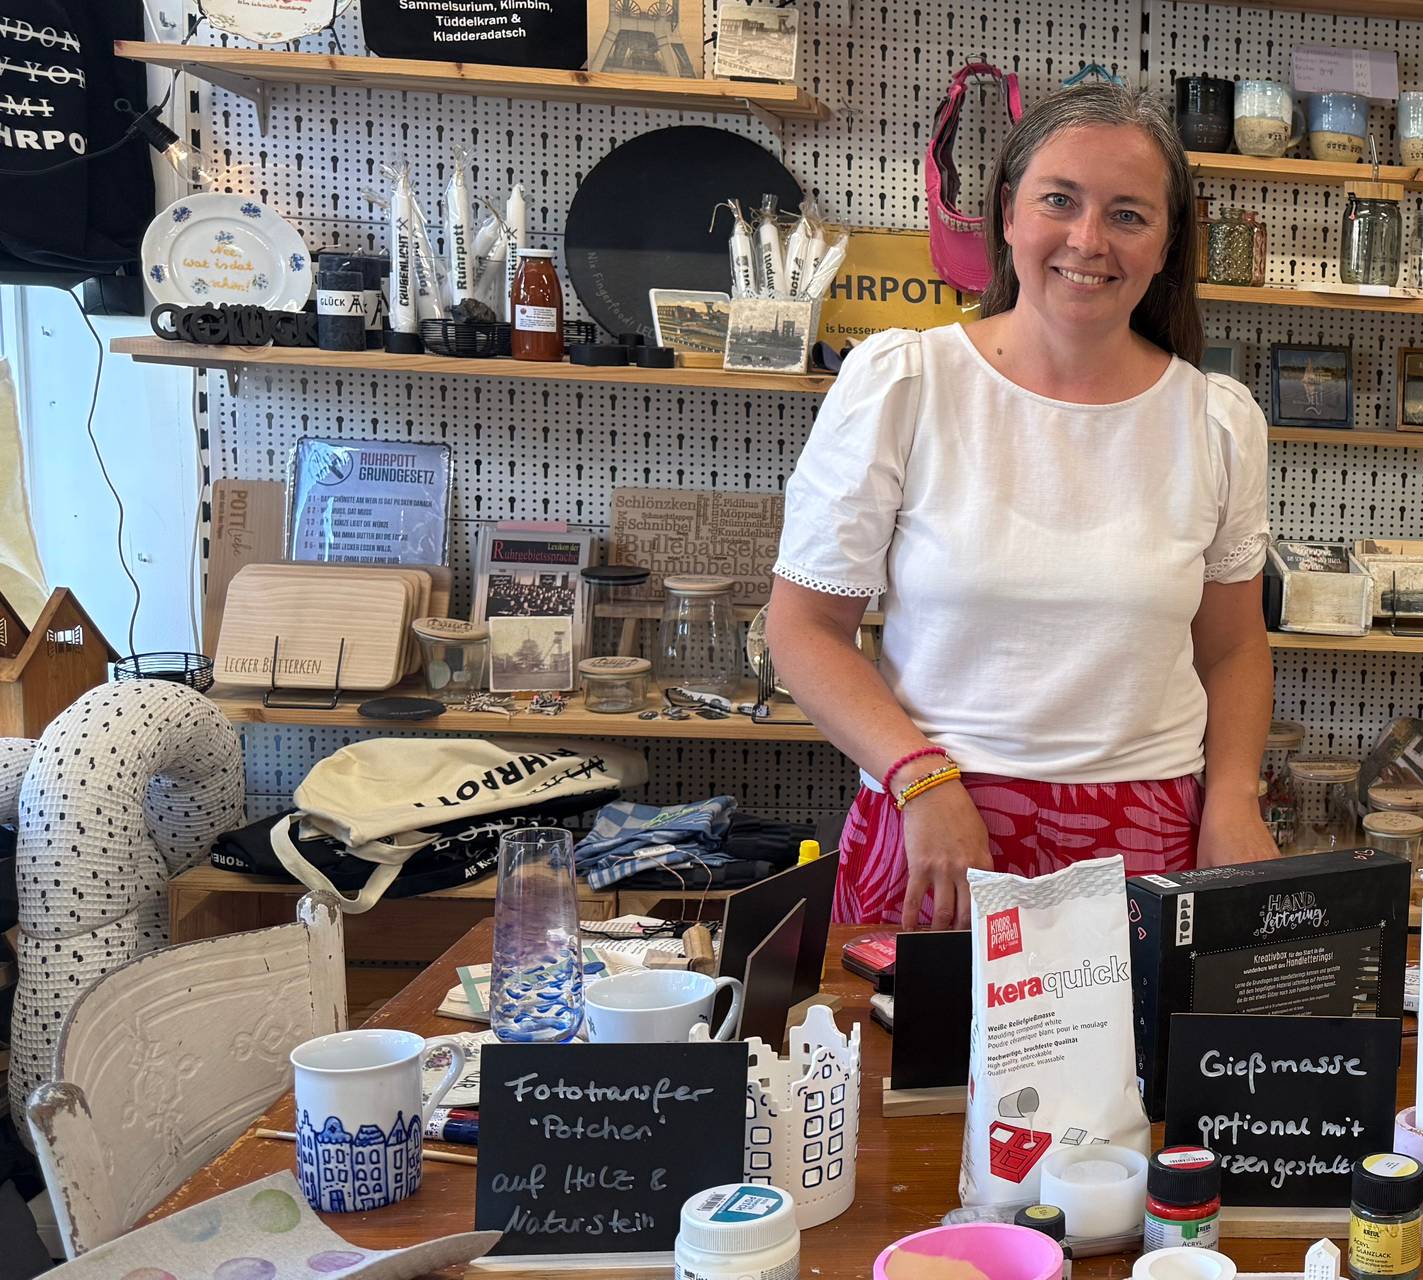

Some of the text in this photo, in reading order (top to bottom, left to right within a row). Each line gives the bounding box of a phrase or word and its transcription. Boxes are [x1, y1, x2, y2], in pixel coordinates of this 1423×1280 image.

[400, 1, 497, 12] Sammelsurium,
[436, 14, 521, 27] Tüddelkram &
[433, 27, 526, 42] Kladderadatsch
[0, 123, 88, 155] HRPO
[455, 223, 468, 290] Ruhrpott
[320, 298, 345, 307] GLÜCK
[826, 324, 835, 333] is
[838, 323, 876, 336] besser
[360, 451, 417, 468] RUHRPOTT
[359, 466, 435, 485] GRUNDGESETZ
[615, 495, 697, 511] Schlönzken
[723, 498, 759, 509] Fidibus
[627, 518, 692, 533] Schnibbel
[493, 540, 578, 562] Ruhrgebietssprache
[224, 654, 259, 674] LECKER
[1266, 891, 1317, 913] HAND
[1178, 897, 1192, 945] TOPP
[1255, 907, 1328, 935] Lettering
[1253, 950, 1288, 964] Kreativbox
[1286, 951, 1335, 968] Handletterings!
[987, 955, 1130, 1008] keraquick
[987, 1023, 1008, 1033] Weiße
[987, 1017, 1062, 1041] Moulding compound white
[987, 1039, 1009, 1049] Poudre
[1038, 1028, 1056, 1037] blanc
[1056, 1026, 1071, 1035] pour
[1080, 1020, 1108, 1030] moulage
[1023, 1041, 1053, 1053] bruchfeste
[1054, 1037, 1078, 1047] Qualität
[987, 1061, 1001, 1069] High
[1020, 1049, 1053, 1061] unbreakable
[1036, 1054, 1066, 1066] incassable
[1199, 1048, 1368, 1094] Gießmasse
[504, 1071, 715, 1115] Fototransfer
[1197, 1111, 1365, 1148] optional mit
[1219, 1153, 1356, 1189] rzen gestalte
[491, 1164, 548, 1200] auf
[1353, 1236, 1370, 1249] ACRYL
[1363, 1229, 1380, 1238] KREUL
[1356, 1246, 1392, 1259] GLANZLACK
